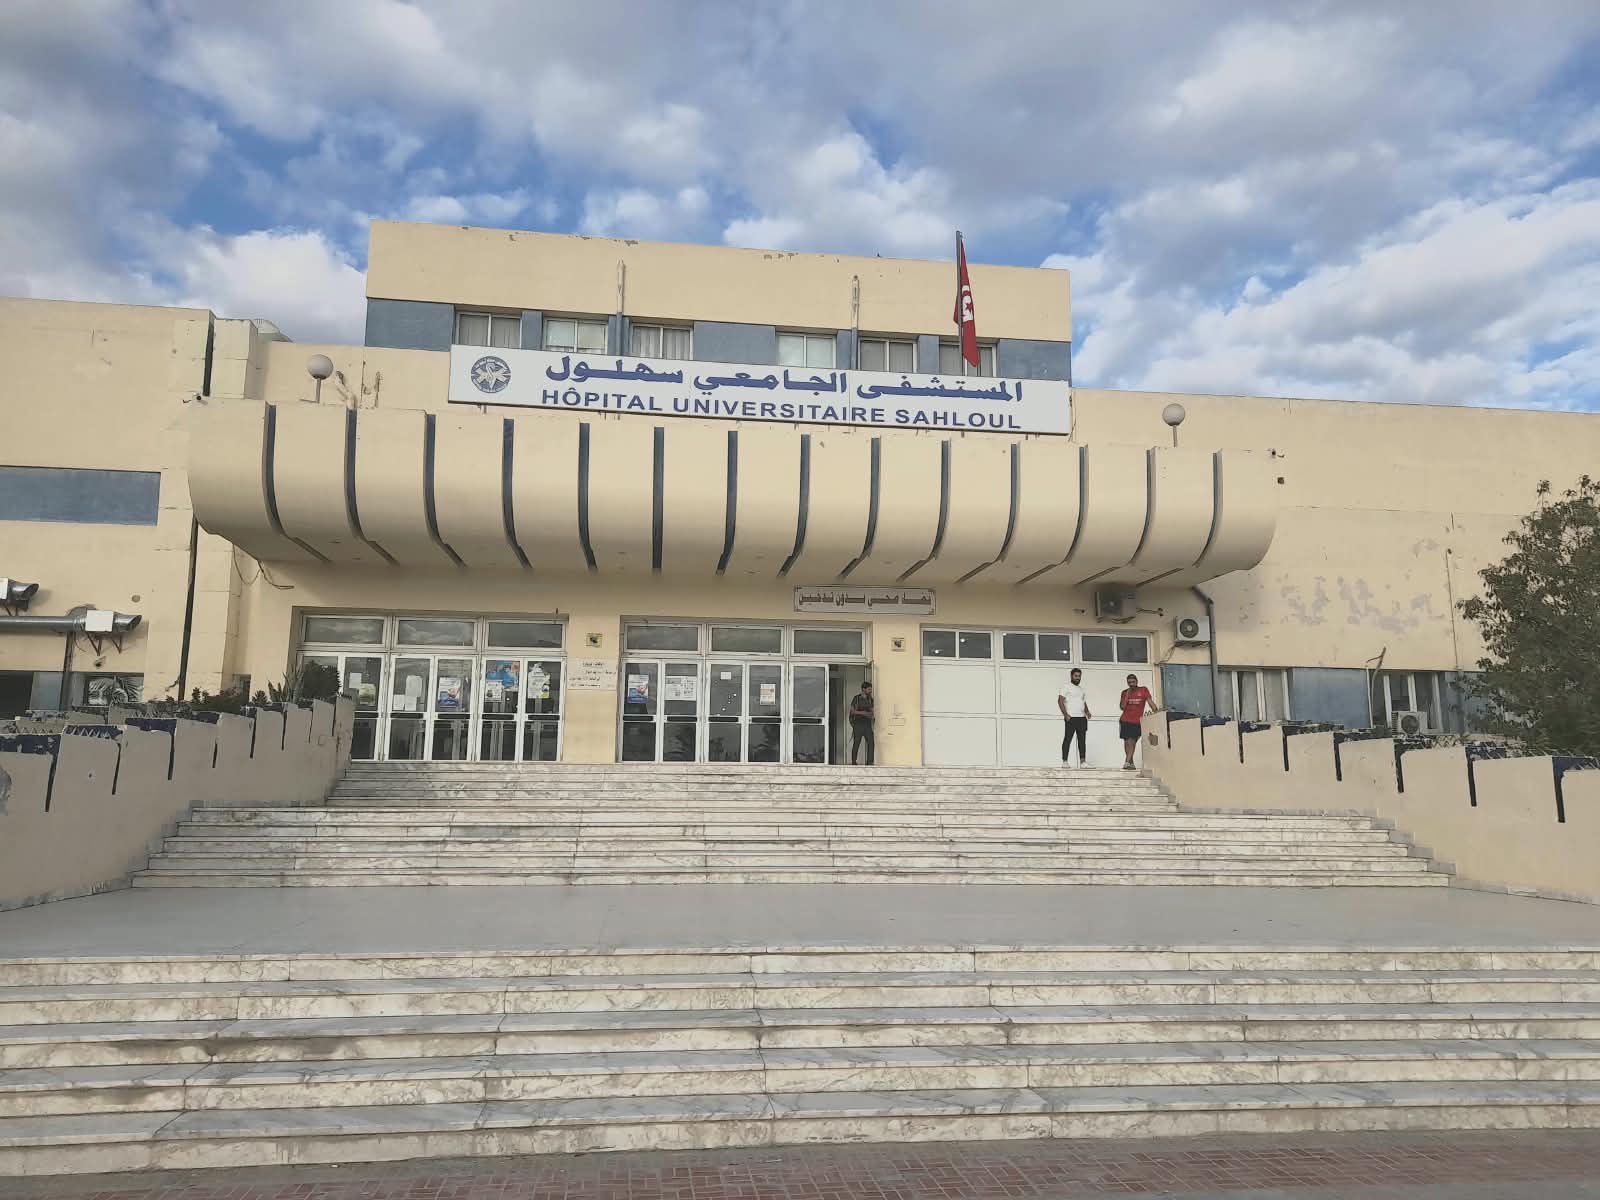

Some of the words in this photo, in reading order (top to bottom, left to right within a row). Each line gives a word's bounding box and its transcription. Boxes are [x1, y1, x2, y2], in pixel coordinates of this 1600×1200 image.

[545, 355, 684, 383] سهلول
[693, 368, 848, 396] الجامعي
[857, 374, 1023, 402] المستشفى
[542, 387, 664, 412] HÔPITAL
[673, 396, 885, 423] UNIVERSITAIRE
[895, 408, 1022, 430] SAHLOUL
